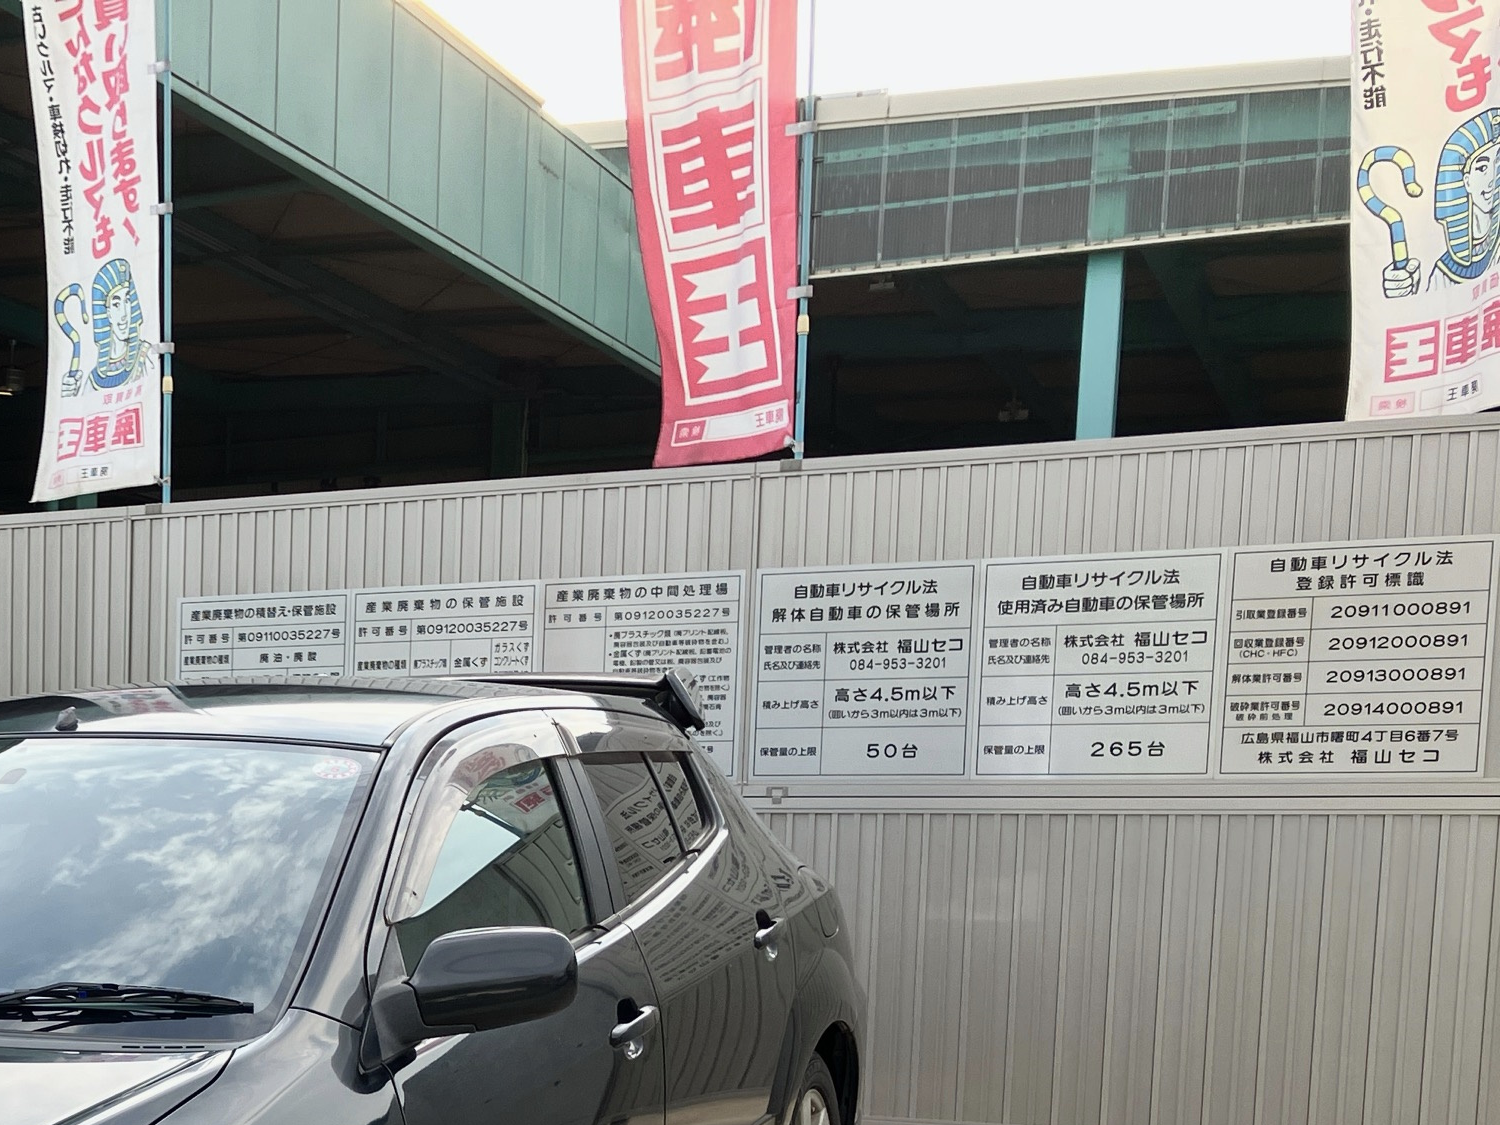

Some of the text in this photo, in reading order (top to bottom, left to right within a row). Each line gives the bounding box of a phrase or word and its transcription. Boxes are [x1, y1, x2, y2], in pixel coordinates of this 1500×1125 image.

[1270, 550, 1454, 573] 自動車リサイクル法
[1022, 569, 1180, 591] 自動車リサイクル法
[1295, 572, 1425, 591] 登録許可標識
[556, 582, 728, 603] 産業廃棄物の中間処理場
[794, 579, 938, 599] 自動車リサイクル法
[365, 594, 525, 614] 産業廃棄物の保管施設
[998, 592, 1205, 615] 使用済み自動車の保管場所
[1330, 601, 1471, 619] 20911000891
[548, 613, 602, 624] 許可番号
[614, 607, 731, 621] 第09120035227号
[772, 601, 961, 623] 解体自動車の保管場所
[1235, 607, 1307, 621] 引取業登録番号
[237, 628, 341, 643] 第09110035227号
[358, 625, 408, 638] 許可番号
[416, 620, 529, 636] 第09120035227号
[184, 633, 231, 645] 許可番号
[833, 638, 964, 655] 株式会社 福山セコ
[988, 637, 1051, 649] 管理者の名称
[1064, 630, 1208, 648] 株式会社 福山セコ
[1328, 634, 1469, 651] 20912000891
[764, 644, 822, 655] 管理者の名称
[1081, 650, 1189, 665] 084-953-3201
[764, 659, 821, 671] 氏名及び連絡先
[850, 657, 946, 671] 084-953-3201
[987, 654, 1050, 666] 氏名及び連絡先
[1231, 672, 1302, 684] 解体業許可番号
[1325, 667, 1466, 684] 20913000891
[835, 685, 957, 703] 高さ4.5m以下
[1065, 680, 1199, 699] 高さ4.5m以下
[762, 699, 819, 710] 積み上げ高さ
[986, 695, 1048, 706] 積み上げ高さ
[1323, 701, 1464, 717] 20914000891
[1240, 730, 1459, 745] 広島県福山市曙町4丁目6番7号
[760, 747, 817, 757] 保管量の上限
[866, 743, 918, 759] 50台
[983, 745, 1045, 756] 保管量の上限
[1090, 740, 1165, 757] 265台
[1257, 749, 1440, 765] 株式会社 福山セコ
